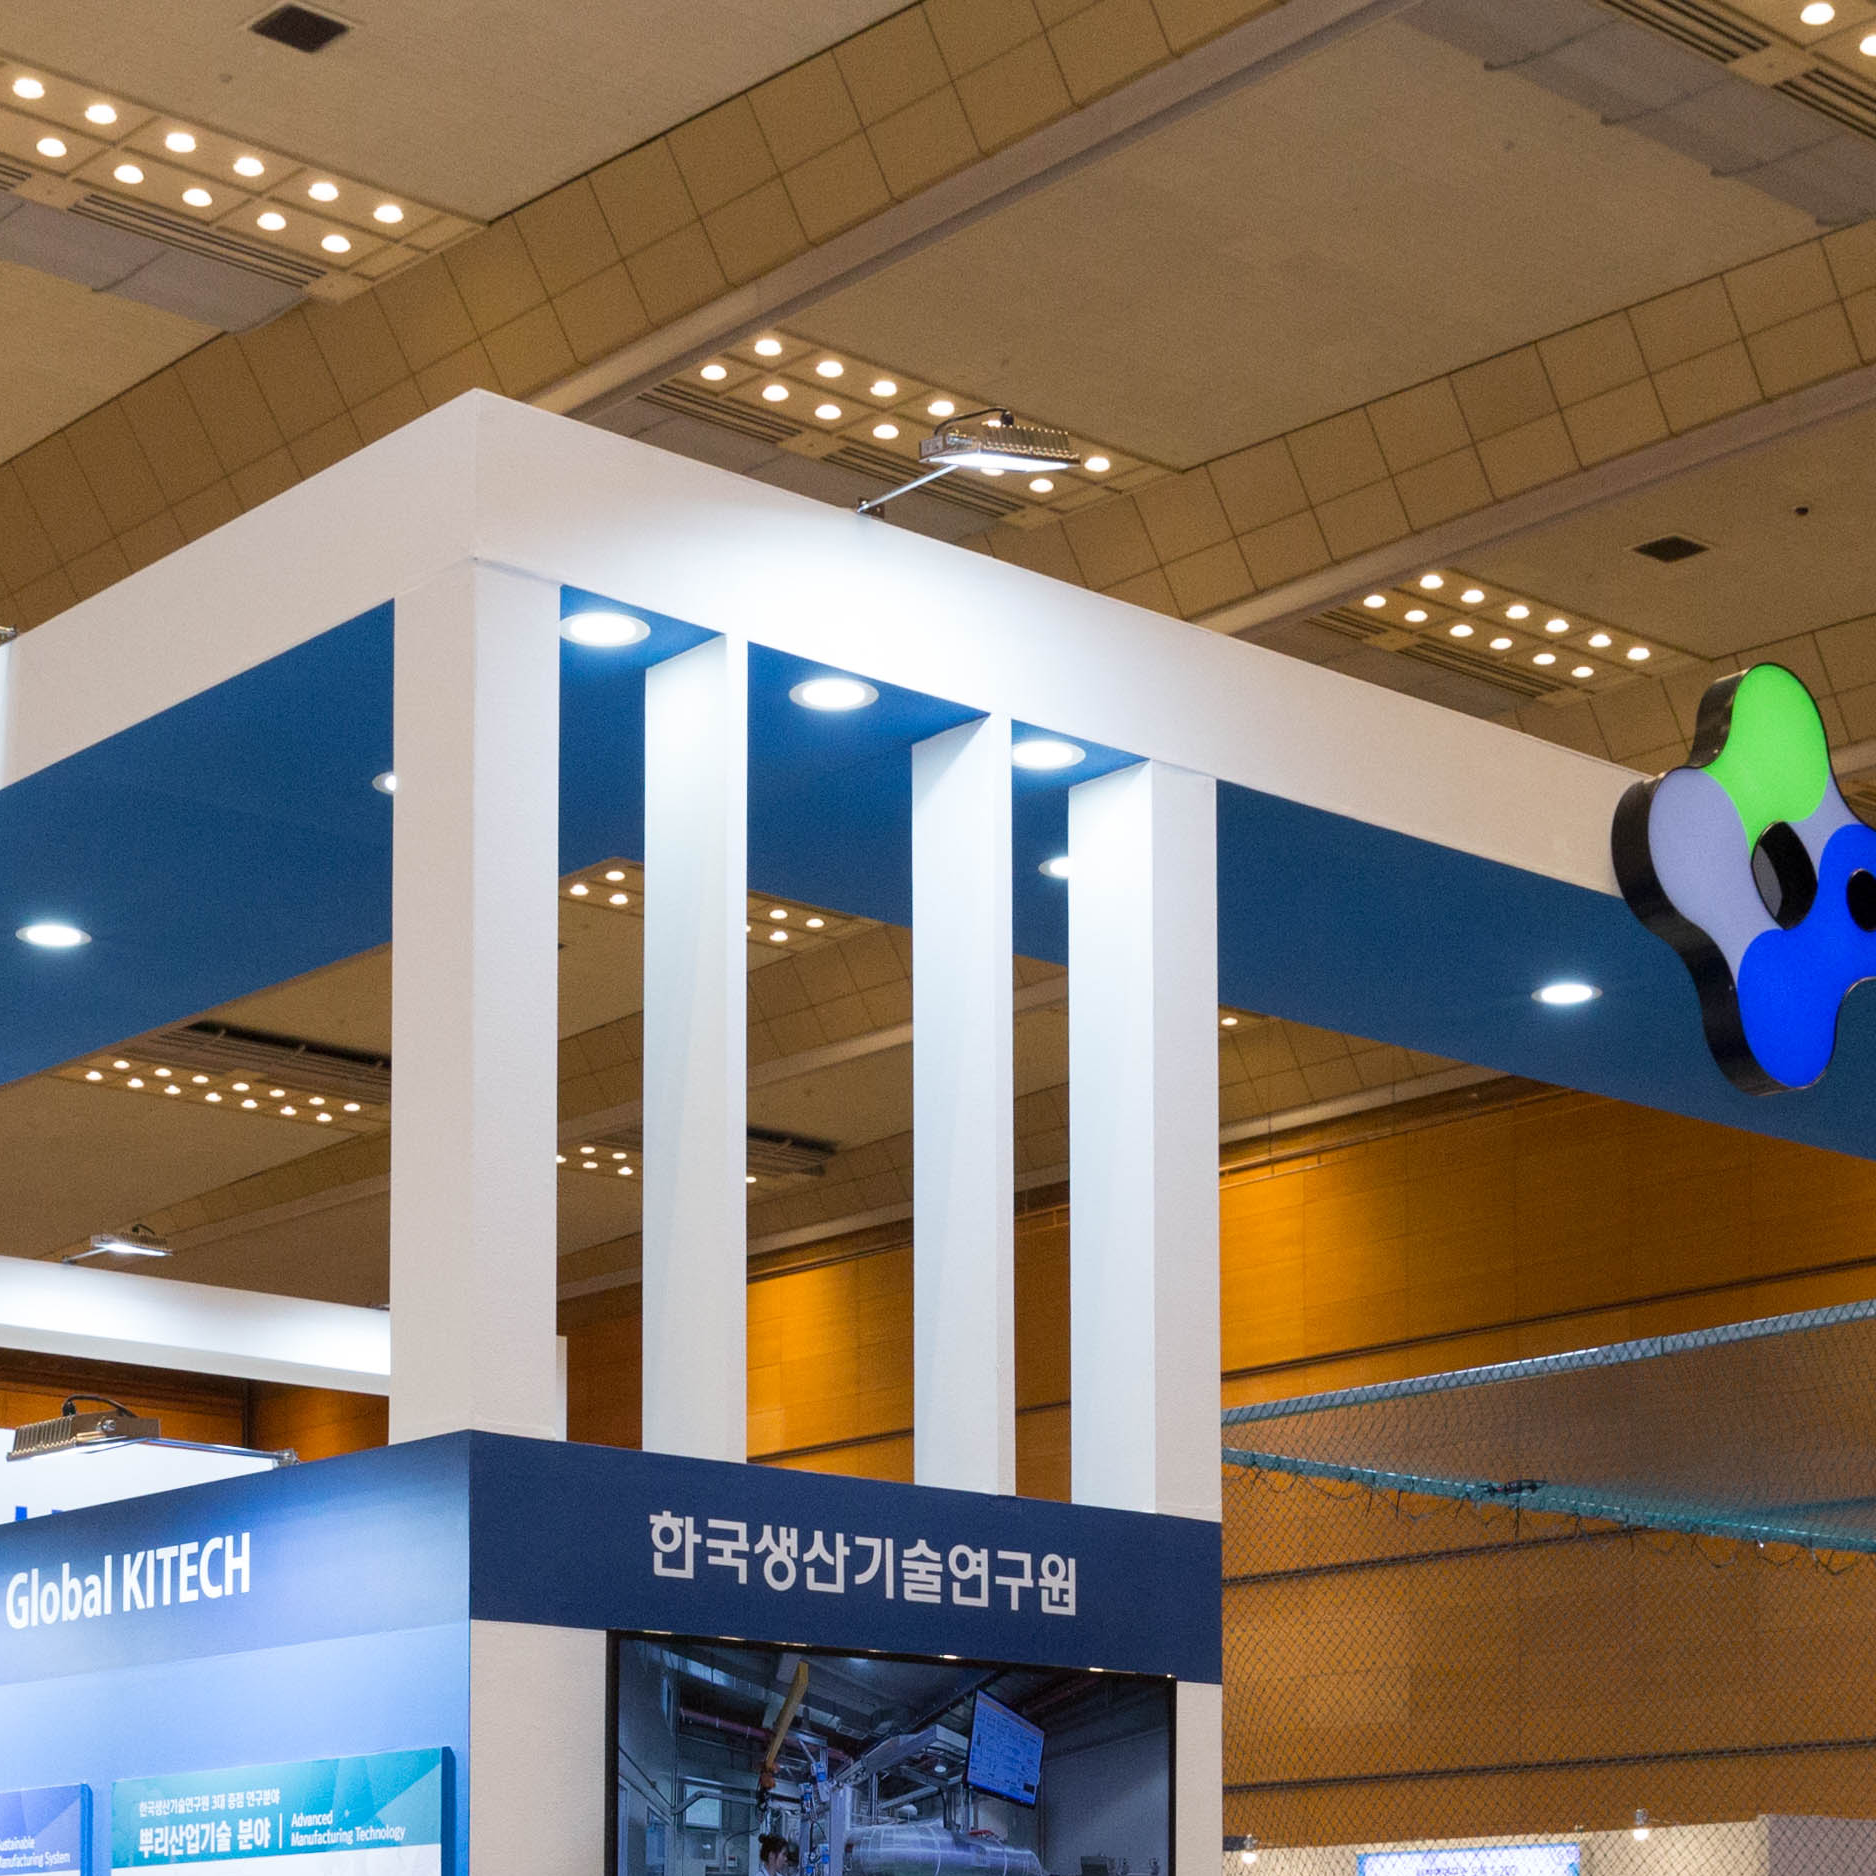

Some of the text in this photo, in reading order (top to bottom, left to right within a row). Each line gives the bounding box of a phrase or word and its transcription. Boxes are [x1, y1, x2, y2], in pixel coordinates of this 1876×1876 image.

[649, 1510, 1079, 1617] 한국생산기술연구원
[4, 1553, 114, 1631] Global
[122, 1532, 252, 1610] KITECH
[139, 1797, 210, 1818] 한국생산기술연구원
[211, 1794, 225, 1811] 3대
[246, 1788, 280, 1808] 연구분야
[291, 1810, 333, 1828] Advanced
[138, 1817, 271, 1858] 뿌리산업기술 분야
[291, 1824, 406, 1847] Manufacturing Technology
[45, 1849, 71, 1866] System
